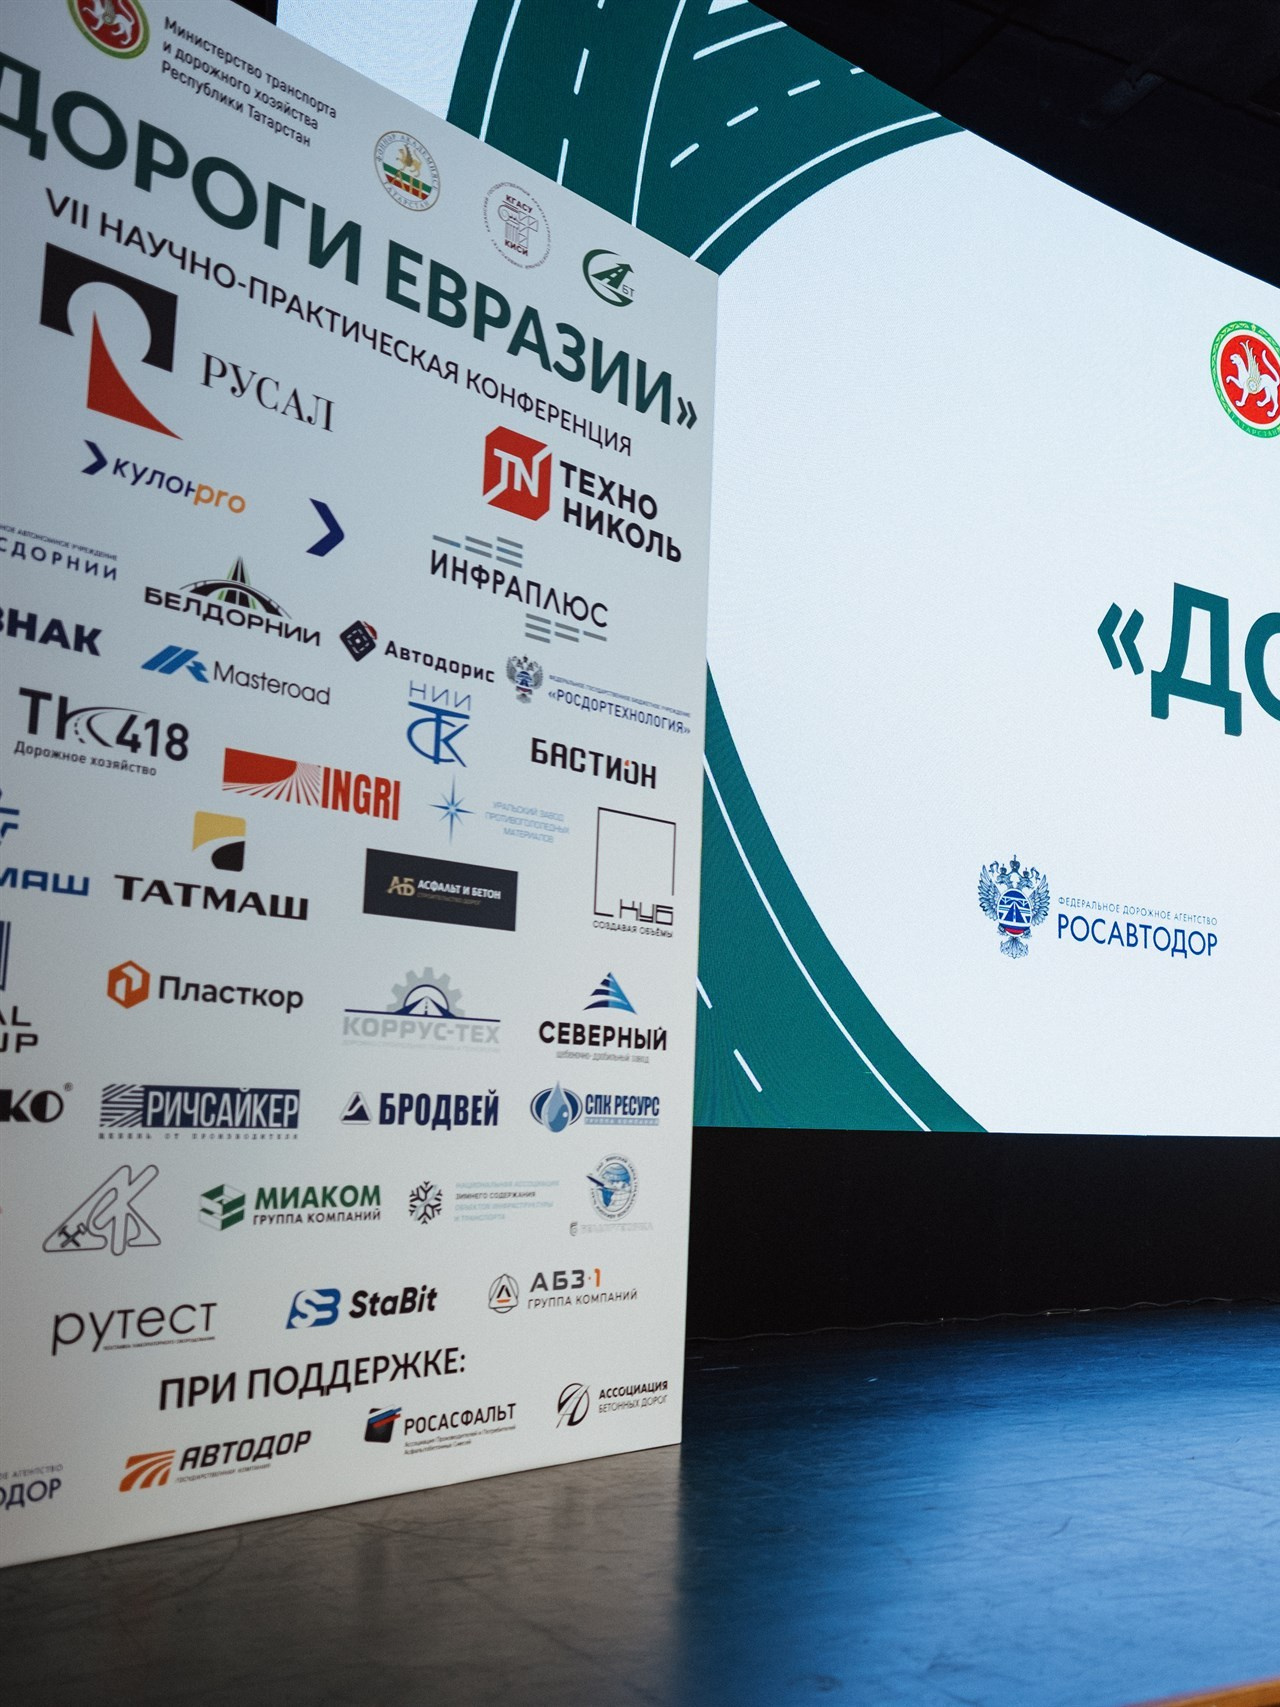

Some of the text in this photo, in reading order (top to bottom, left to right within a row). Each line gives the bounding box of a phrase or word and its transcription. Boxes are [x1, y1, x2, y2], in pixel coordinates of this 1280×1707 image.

[162, 40, 319, 130] и дорожного хозяйства
[164, 16, 337, 119] Министерство транспорта
[161, 60, 311, 147] Республики Татарстан
[505, 194, 533, 213] КГАСУ
[504, 239, 529, 256] КИСИ
[46, 187, 89, 229] VII
[100, 211, 459, 384] НАУЧНО-ПРАКТИЧЕСКАЯ
[466, 368, 632, 457] КОНФЕРЕНЦИЯ
[386, 239, 698, 430] ЕВРАЗИИ»
[200, 352, 335, 432] РУСАЛ
[560, 460, 658, 520] ТЕХНО
[563, 497, 682, 563] НИКОЛЬ
[430, 549, 608, 628] ИНФРАПЛЮС
[0, 606, 102, 657] НАК
[144, 586, 320, 646] БЕЛДОРНИИ
[213, 661, 330, 705] Masteroad
[385, 641, 495, 683] Автодорис
[409, 680, 471, 711] НИИ
[548, 689, 691, 735] «РОСДОРТЕХНОЛОГИЯ»
[14, 741, 157, 776] Дорожное хозяйство
[531, 737, 657, 789] БАСТИОН
[321, 767, 400, 821] INGRI
[114, 874, 308, 920] ТАТМАШ
[417, 880, 462, 895] АСФАЛЬТ
[463, 886, 470, 896] И
[471, 887, 502, 900] БЕТОН
[1058, 896, 1218, 926] ФЕДЕРАЛЬНОЕ ДОРОЖНОЕ АГЕНТСТВО
[593, 920, 638, 934] СОЗДАВАЯ
[1057, 913, 1218, 959] РОСАВТОДОР
[159, 975, 304, 1014] Пласткор
[343, 1016, 500, 1044] КОРРУС-ТЕХ
[539, 1020, 667, 1051] СЕВЕРНЫЙ
[146, 1086, 299, 1128] РИЧСАЙКЕР
[379, 1089, 499, 1131] БРОДВЕЙ
[585, 1093, 660, 1117] СПК РЕСУРС
[253, 1208, 381, 1225] ГРУППА КОМПАНИЙ
[255, 1185, 381, 1210] МИАКОМ
[349, 1285, 438, 1319] StaBit
[528, 1288, 638, 1309] ГРУППА КОМПАНИЙ
[52, 1303, 217, 1356] рутест
[159, 1346, 466, 1411] ПРИ ПОДДЕРЖКЕ:
[599, 1380, 668, 1400] АССОЦИАЦИЯ
[404, 1403, 516, 1436] РОСАСФАЛЬТ
[598, 1394, 668, 1413] БЕТОННЫХ ДОРОГ
[180, 1430, 312, 1471] АВТОДОР
